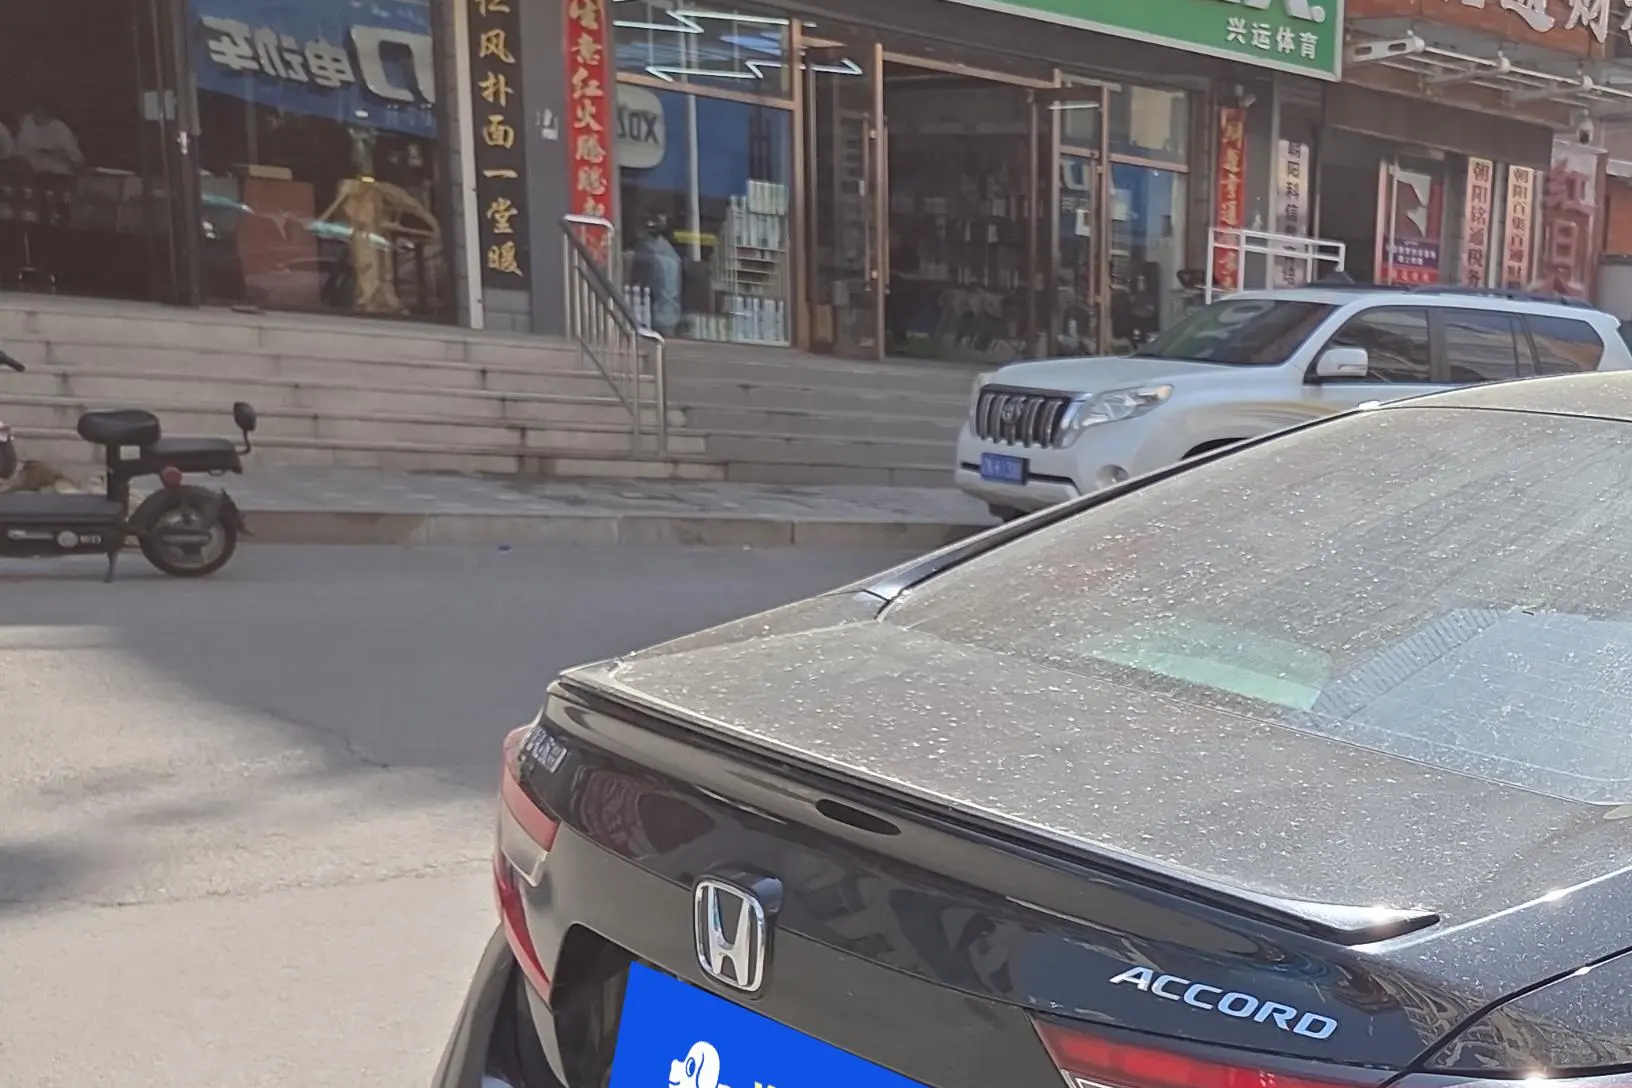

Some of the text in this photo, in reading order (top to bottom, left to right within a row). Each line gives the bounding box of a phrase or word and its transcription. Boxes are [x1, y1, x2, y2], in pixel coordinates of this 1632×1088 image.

[1225, 16, 1319, 59] 兴运体育
[1109, 966, 1339, 1041] ACCORD
